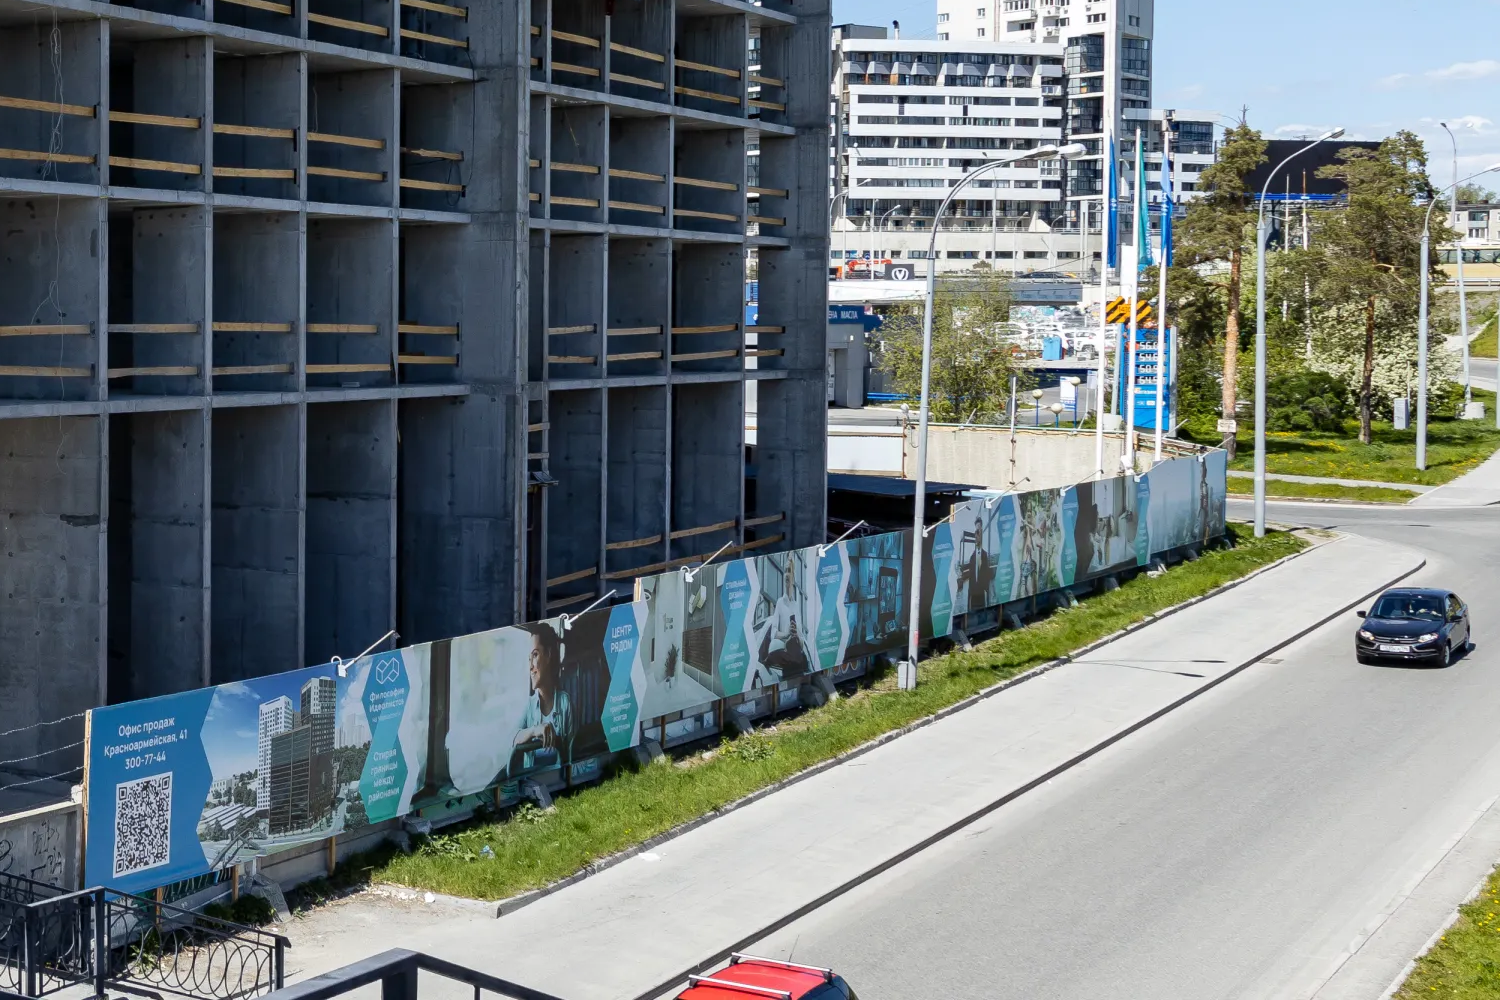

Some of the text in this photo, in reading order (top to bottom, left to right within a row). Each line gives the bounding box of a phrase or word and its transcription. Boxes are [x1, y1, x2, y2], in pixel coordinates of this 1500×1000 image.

[828, 310, 859, 320] ЕНА МАСЛА
[611, 624, 632, 639] ЦЕНТР
[610, 638, 633, 653] РЯДОМ
[369, 686, 405, 702] Философия
[369, 699, 405, 713] Идеалистов
[118, 717, 176, 738] Офис продаж
[104, 728, 188, 758] Красноармейская, 41
[124, 750, 166, 770] 300-77-44
[373, 748, 397, 762] Стирая
[370, 764, 398, 776] границы
[373, 775, 395, 788] между
[368, 787, 400, 806] районами
